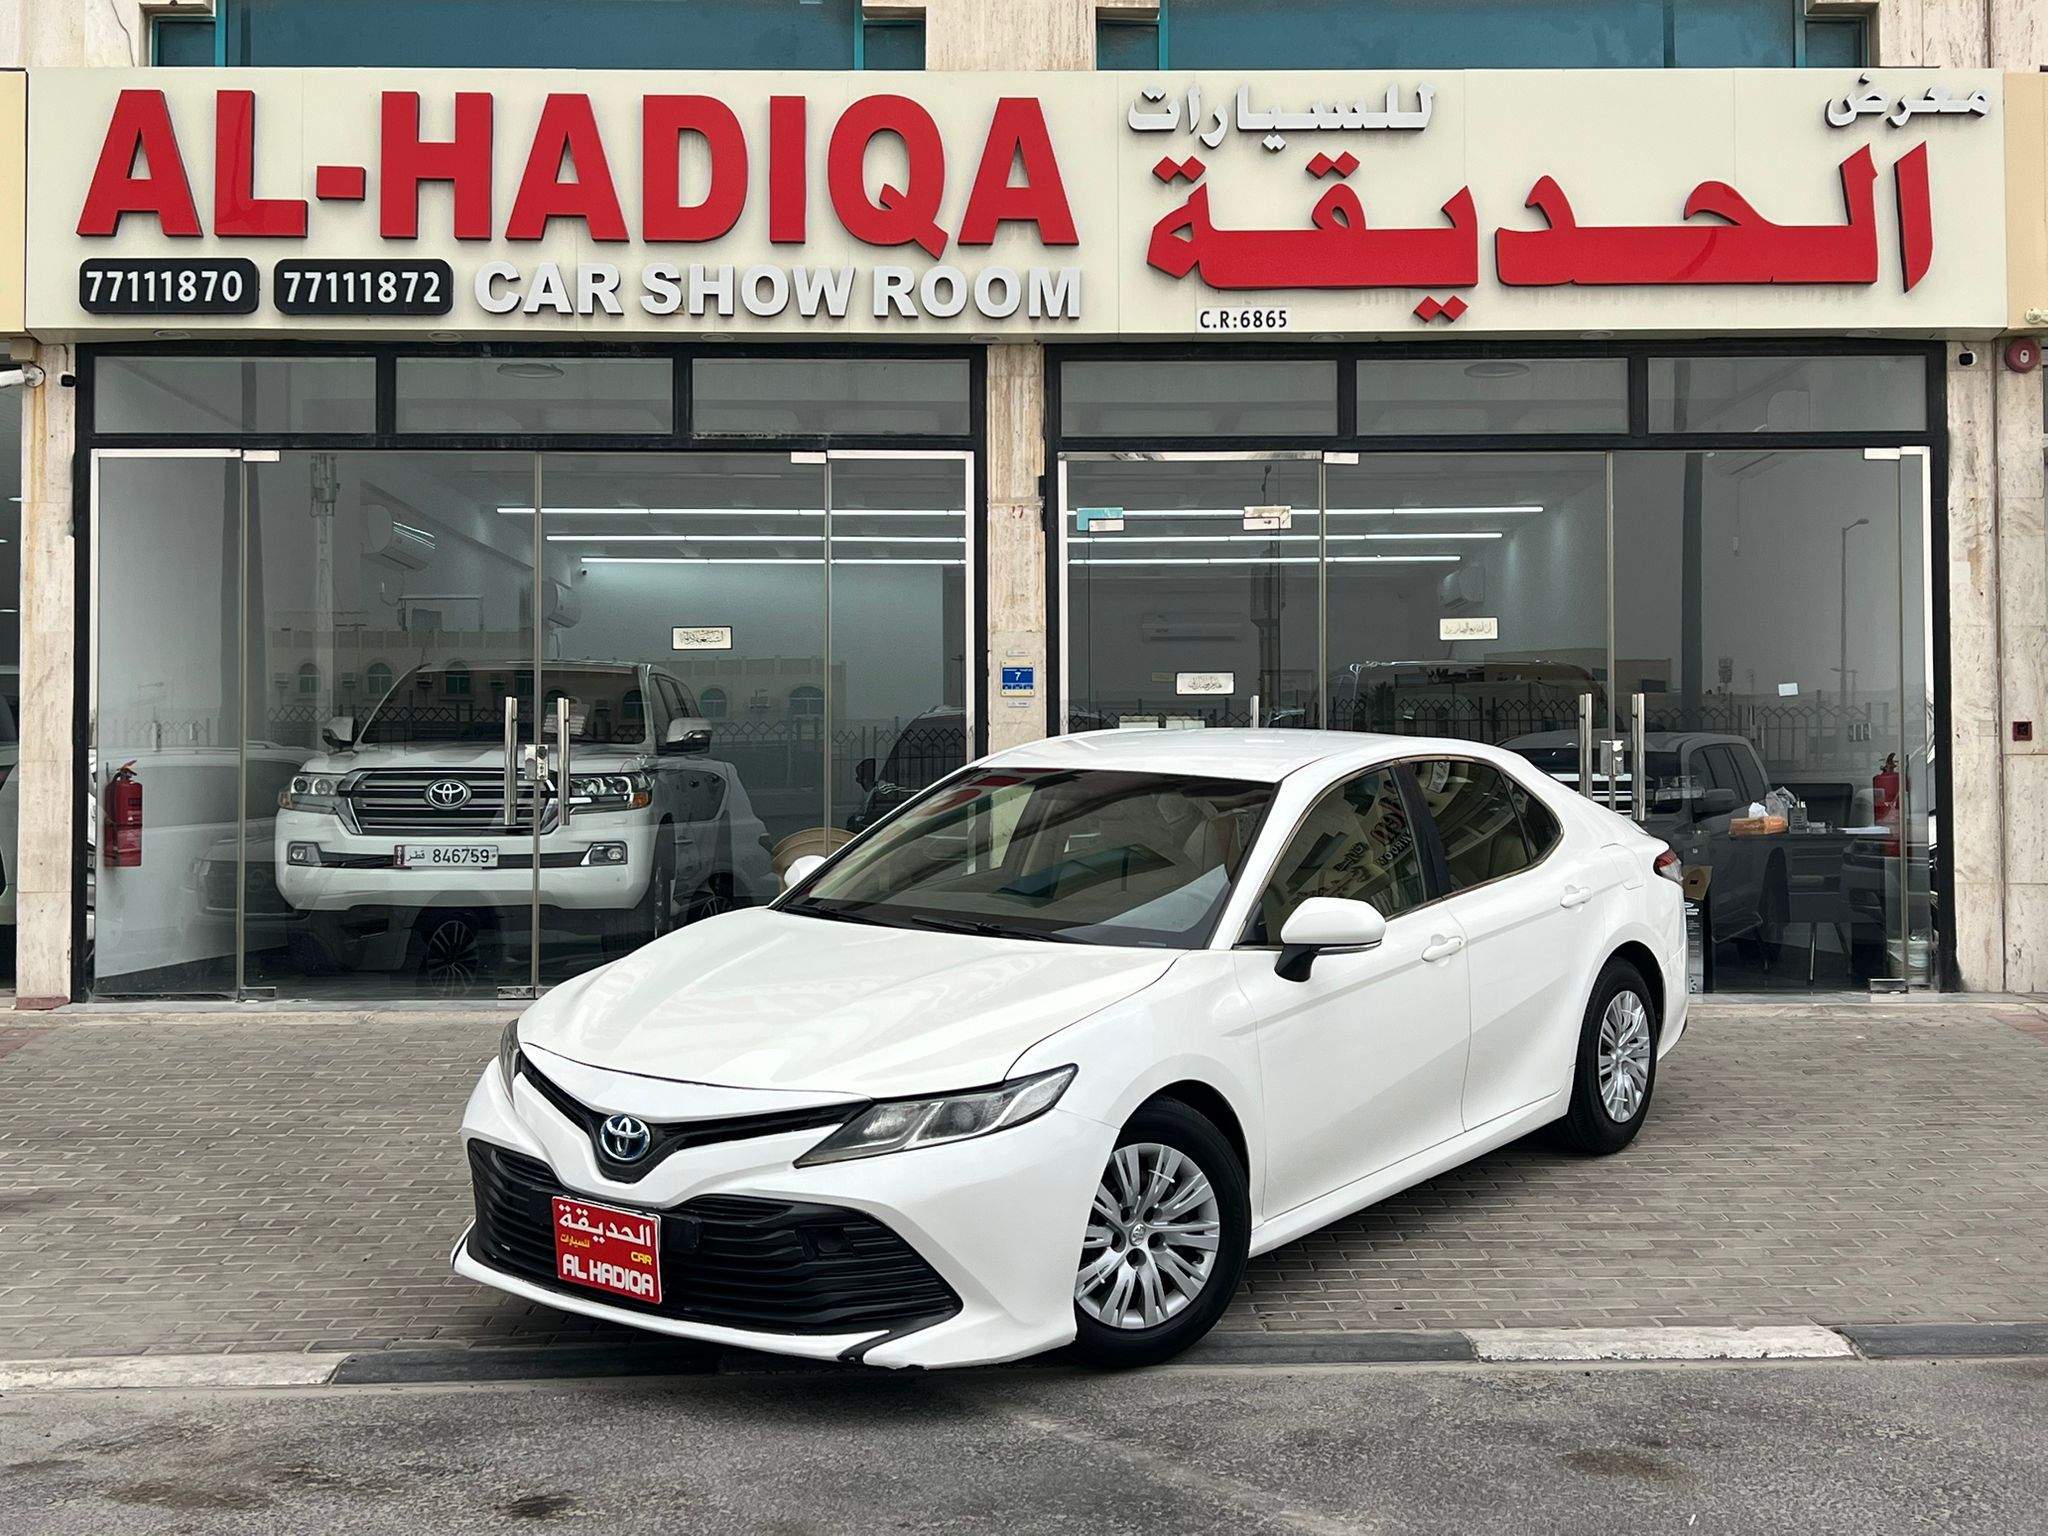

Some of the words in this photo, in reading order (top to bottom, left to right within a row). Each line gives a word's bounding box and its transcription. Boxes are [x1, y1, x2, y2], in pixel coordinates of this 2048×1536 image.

[1127, 81, 1437, 150] للسيارات
[1825, 72, 1991, 128] معرض
[76, 88, 1080, 260] AL-HADIQA
[1147, 140, 1935, 323] الحديقة
[85, 269, 244, 303] 77111870
[283, 270, 442, 304] 77111872
[473, 262, 624, 316] CAR
[639, 262, 856, 317] SHOW
[873, 264, 1082, 320] ROOM
[1199, 309, 1288, 329] C.R:6865
[1014, 671, 1022, 681] 7
[432, 848, 489, 864] 846759
[559, 1204, 651, 1247] الحديقة
[562, 1253, 588, 1280] AL
[589, 1259, 654, 1297] HADIQA
[630, 1251, 653, 1266] CAR
